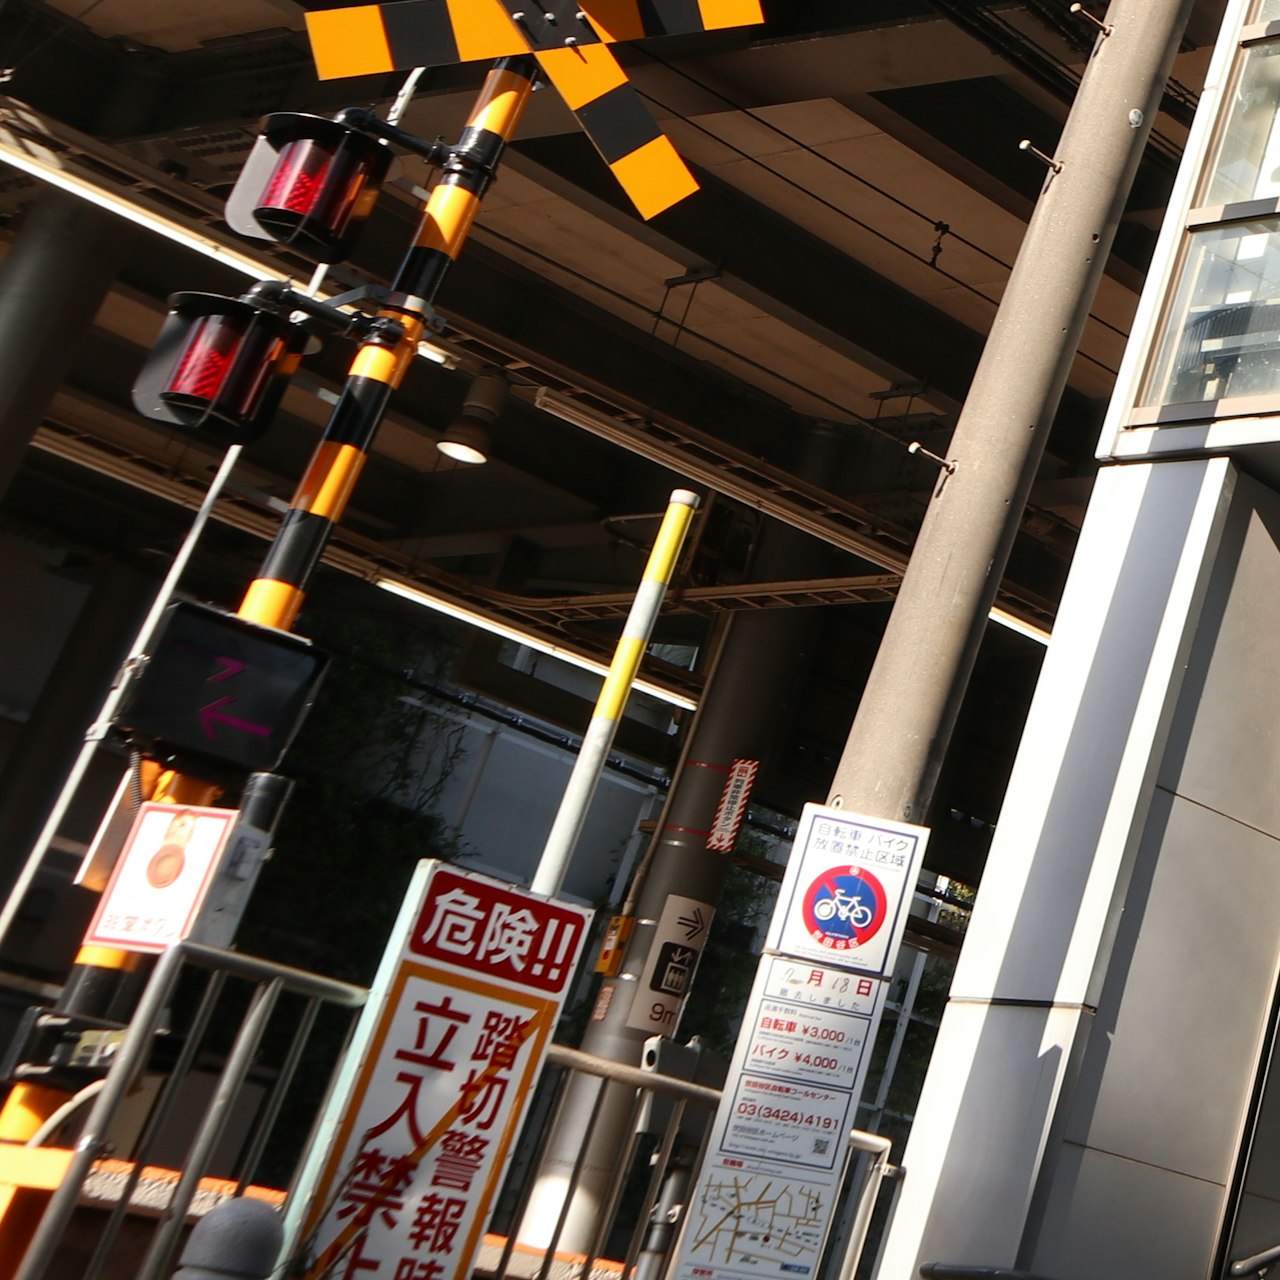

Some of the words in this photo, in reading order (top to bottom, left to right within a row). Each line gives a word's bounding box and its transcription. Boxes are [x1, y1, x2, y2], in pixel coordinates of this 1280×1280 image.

[813, 837, 906, 868] 放置禁止区域
[421, 887, 577, 982] 危険!!
[812, 929, 860, 950] 世田谷区
[807, 968, 824, 987] 月
[856, 978, 873, 997] 日
[649, 1003, 677, 1025] 9m
[760, 1016, 798, 1033] 自転車
[802, 1024, 845, 1043] ¥3,000
[752, 1044, 789, 1060] バイク
[794, 1052, 838, 1070] ¥4,000
[737, 1102, 840, 1130] 03(3424)4191
